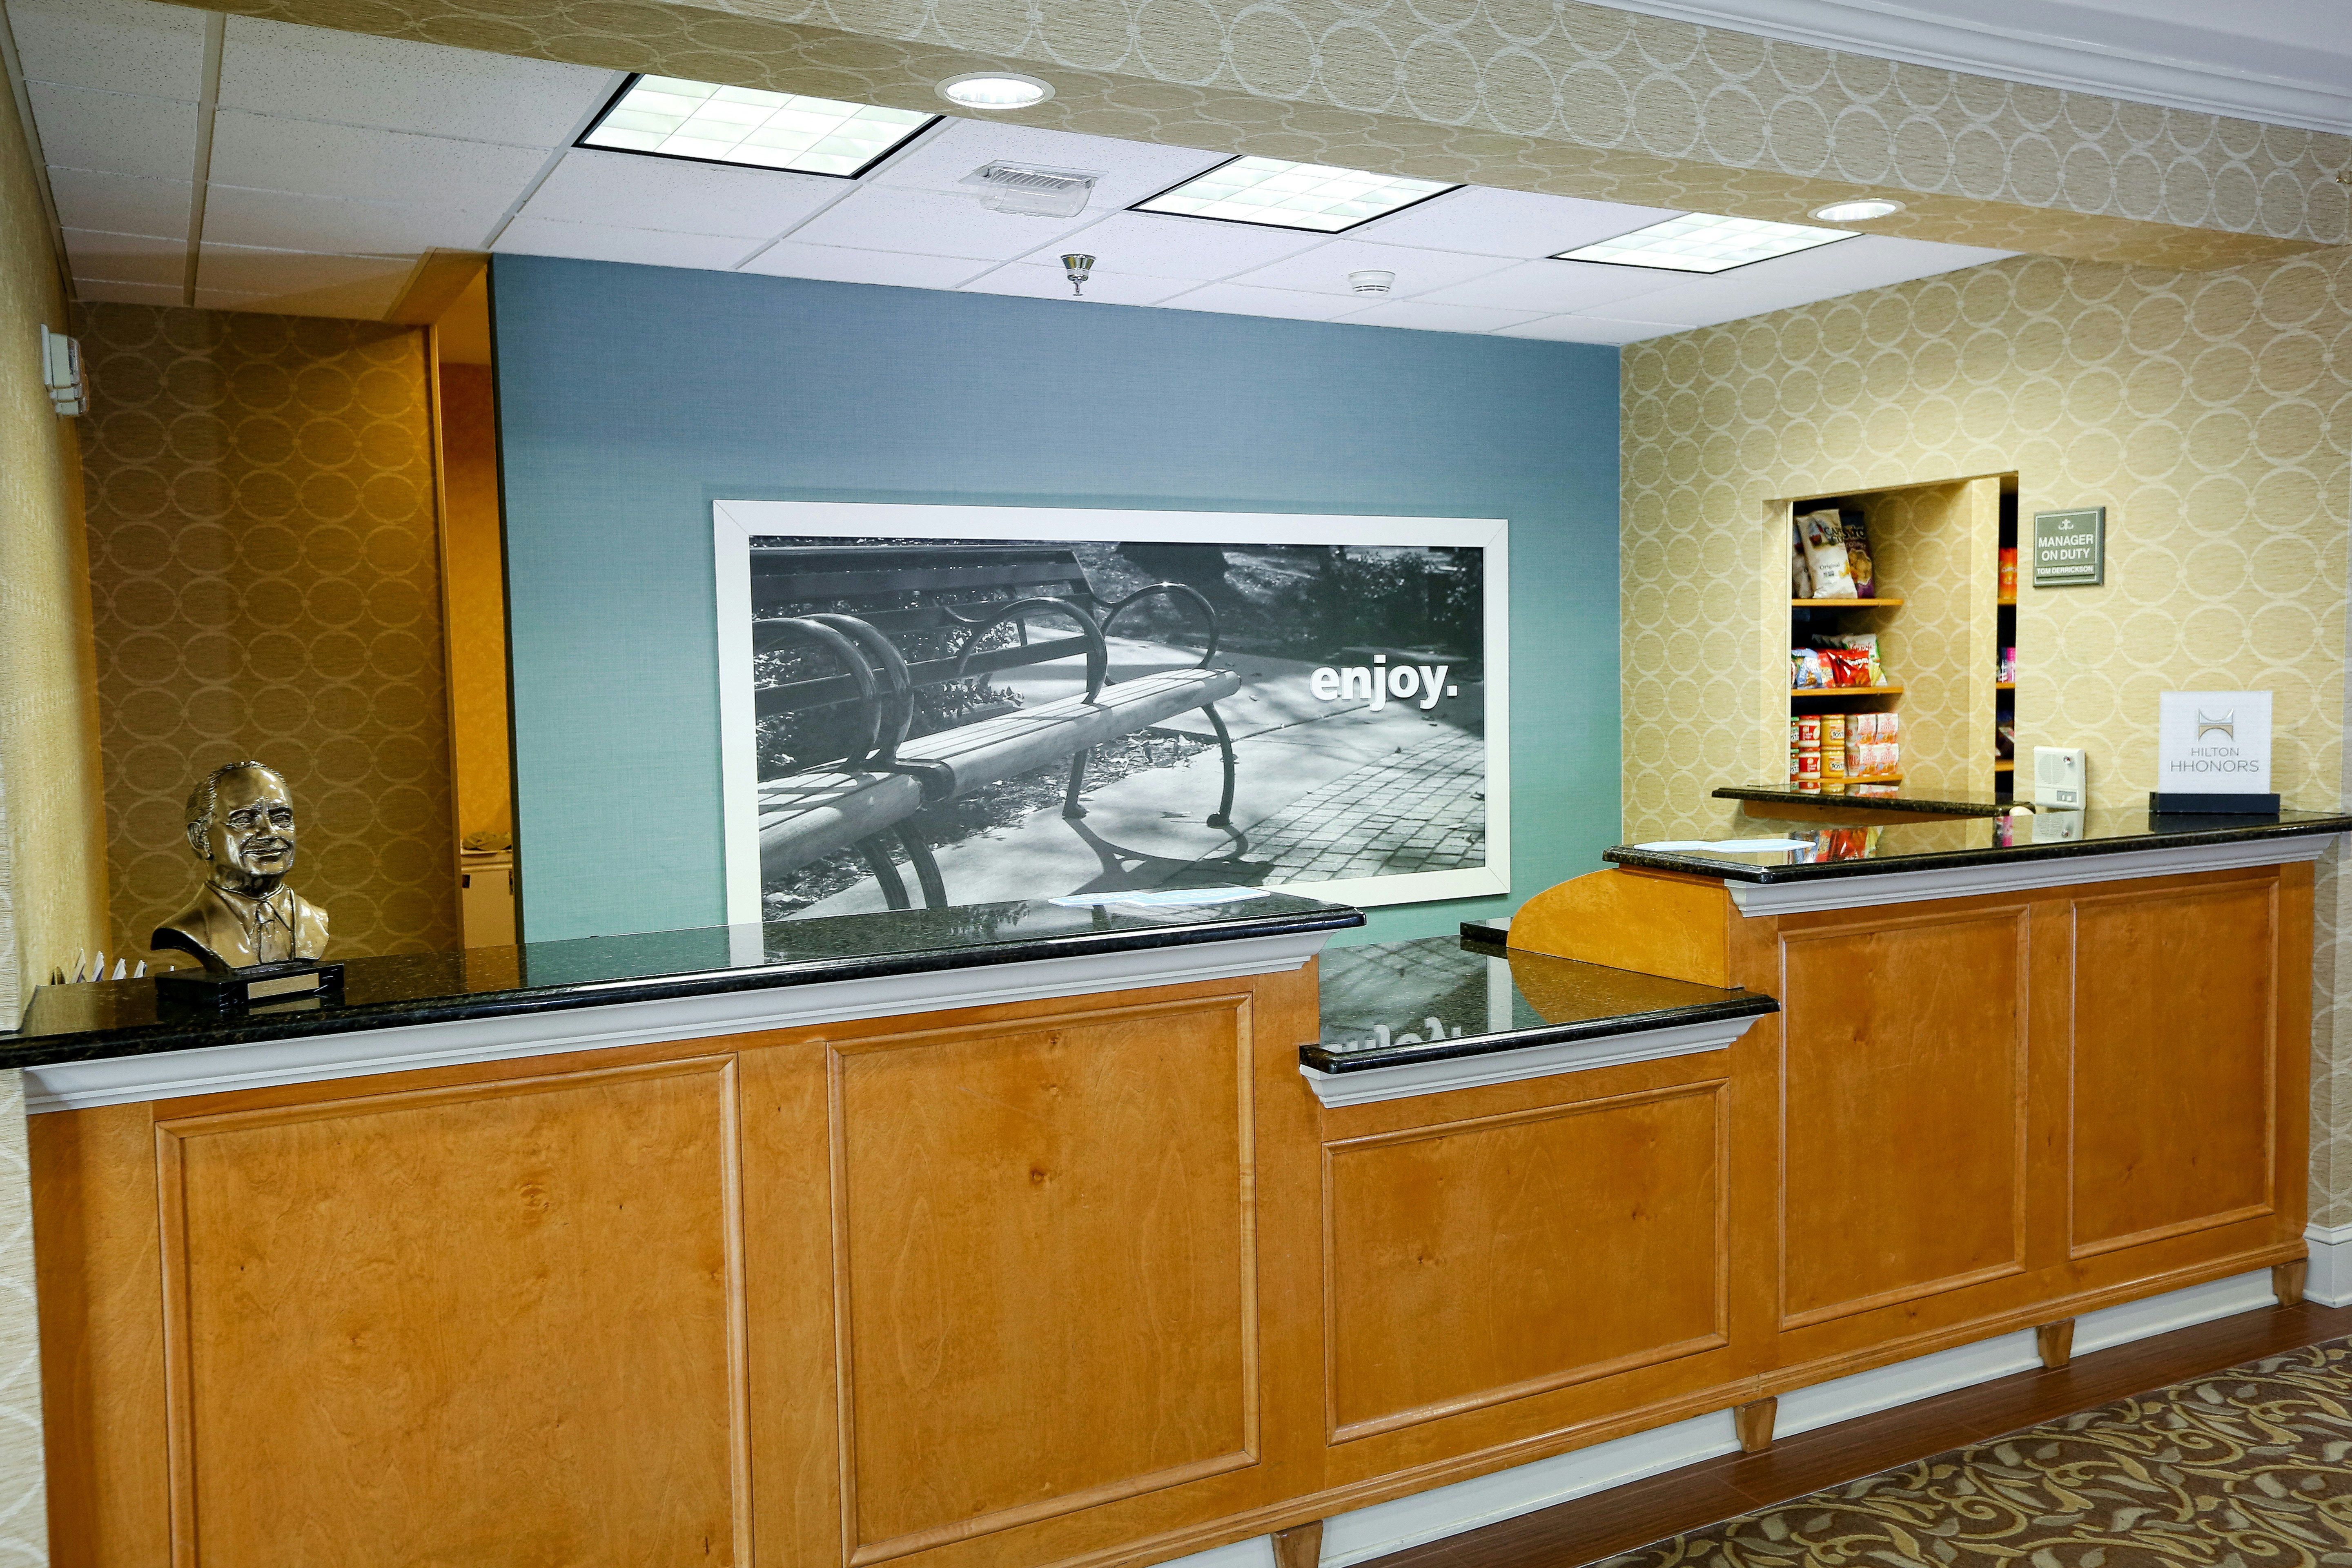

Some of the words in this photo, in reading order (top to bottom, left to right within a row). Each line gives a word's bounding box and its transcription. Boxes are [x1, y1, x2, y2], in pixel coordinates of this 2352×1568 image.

[2038, 533, 2094, 548] MANAGER
[2041, 550, 2058, 561] ON
[2060, 547, 2091, 560] DUTY
[2051, 565, 2093, 574] DERRICKSON
[1310, 654, 1458, 711] enjoy.
[2191, 747, 2239, 757] HILTON
[2170, 760, 2259, 772] HHONORS
